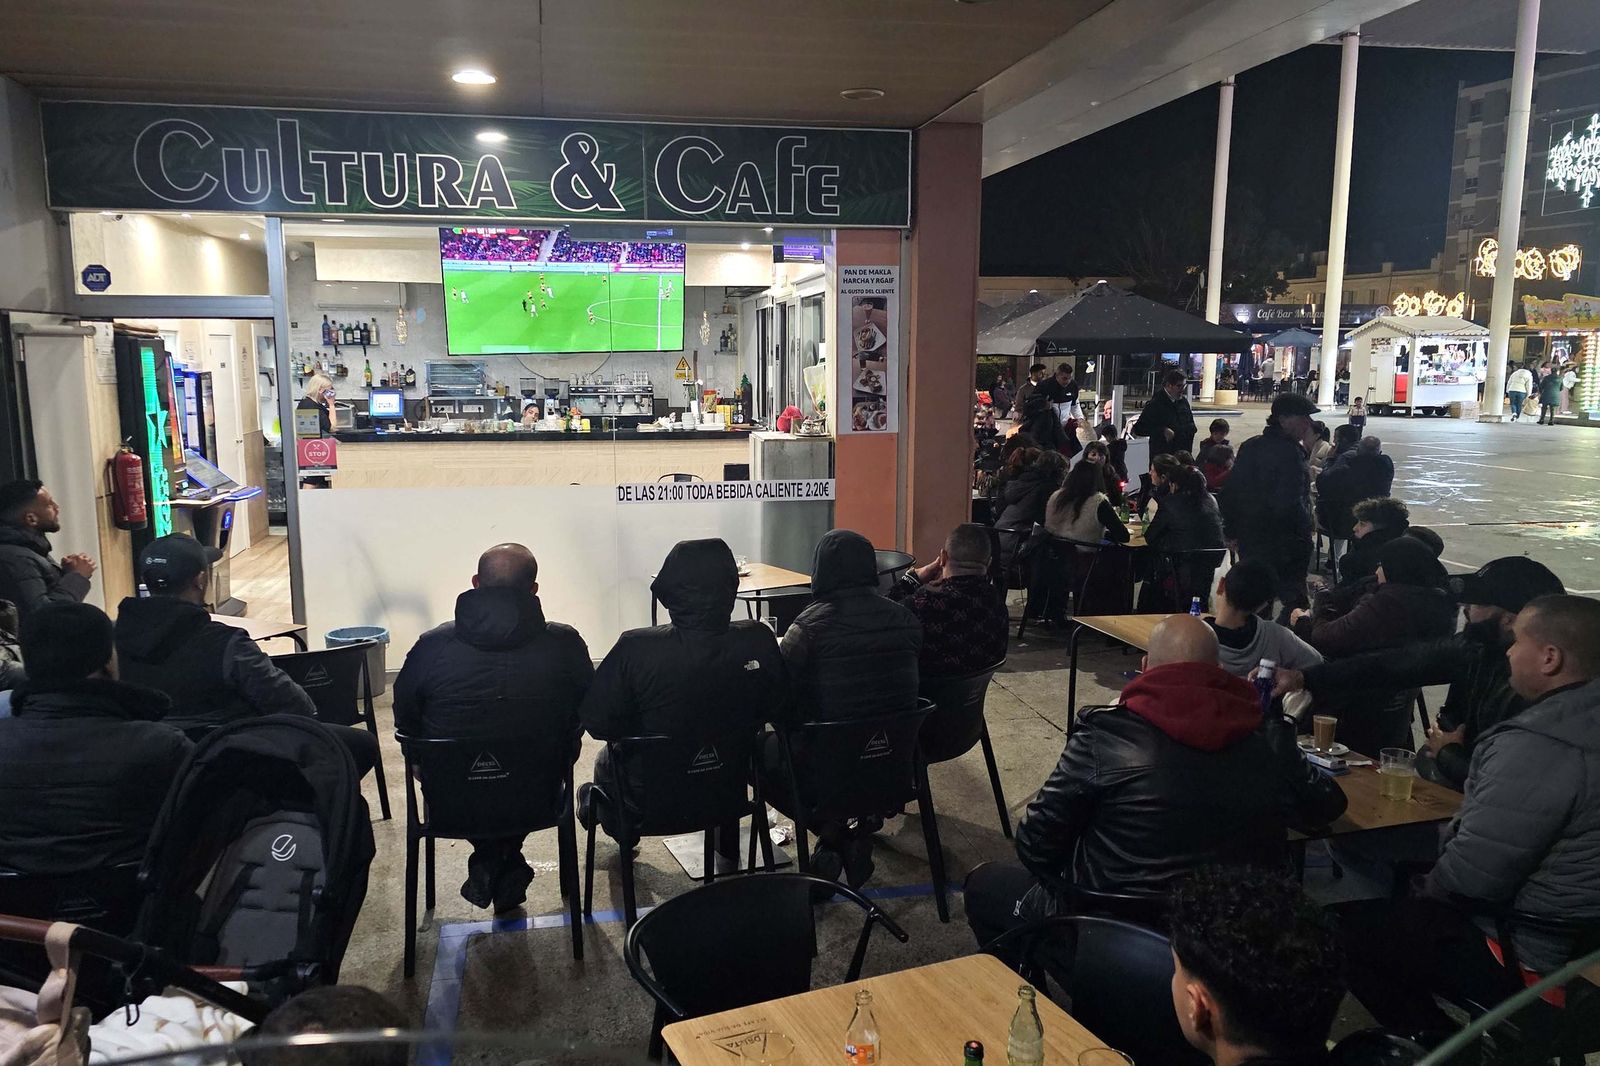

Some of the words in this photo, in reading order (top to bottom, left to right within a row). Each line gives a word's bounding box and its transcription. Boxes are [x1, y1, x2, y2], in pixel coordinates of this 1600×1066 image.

[550, 132, 626, 212] &
[86, 272, 107, 282] ADT
[1256, 307, 1275, 321] Café
[1276, 308, 1293, 319] Bar
[618, 485, 632, 501] DE
[635, 485, 655, 501] LAS
[657, 485, 684, 500] 21:00
[686, 484, 714, 500] TODA
[716, 483, 753, 500] BEBIDA
[755, 482, 803, 498] CALIENTE
[805, 481, 830, 497] 2,20€
